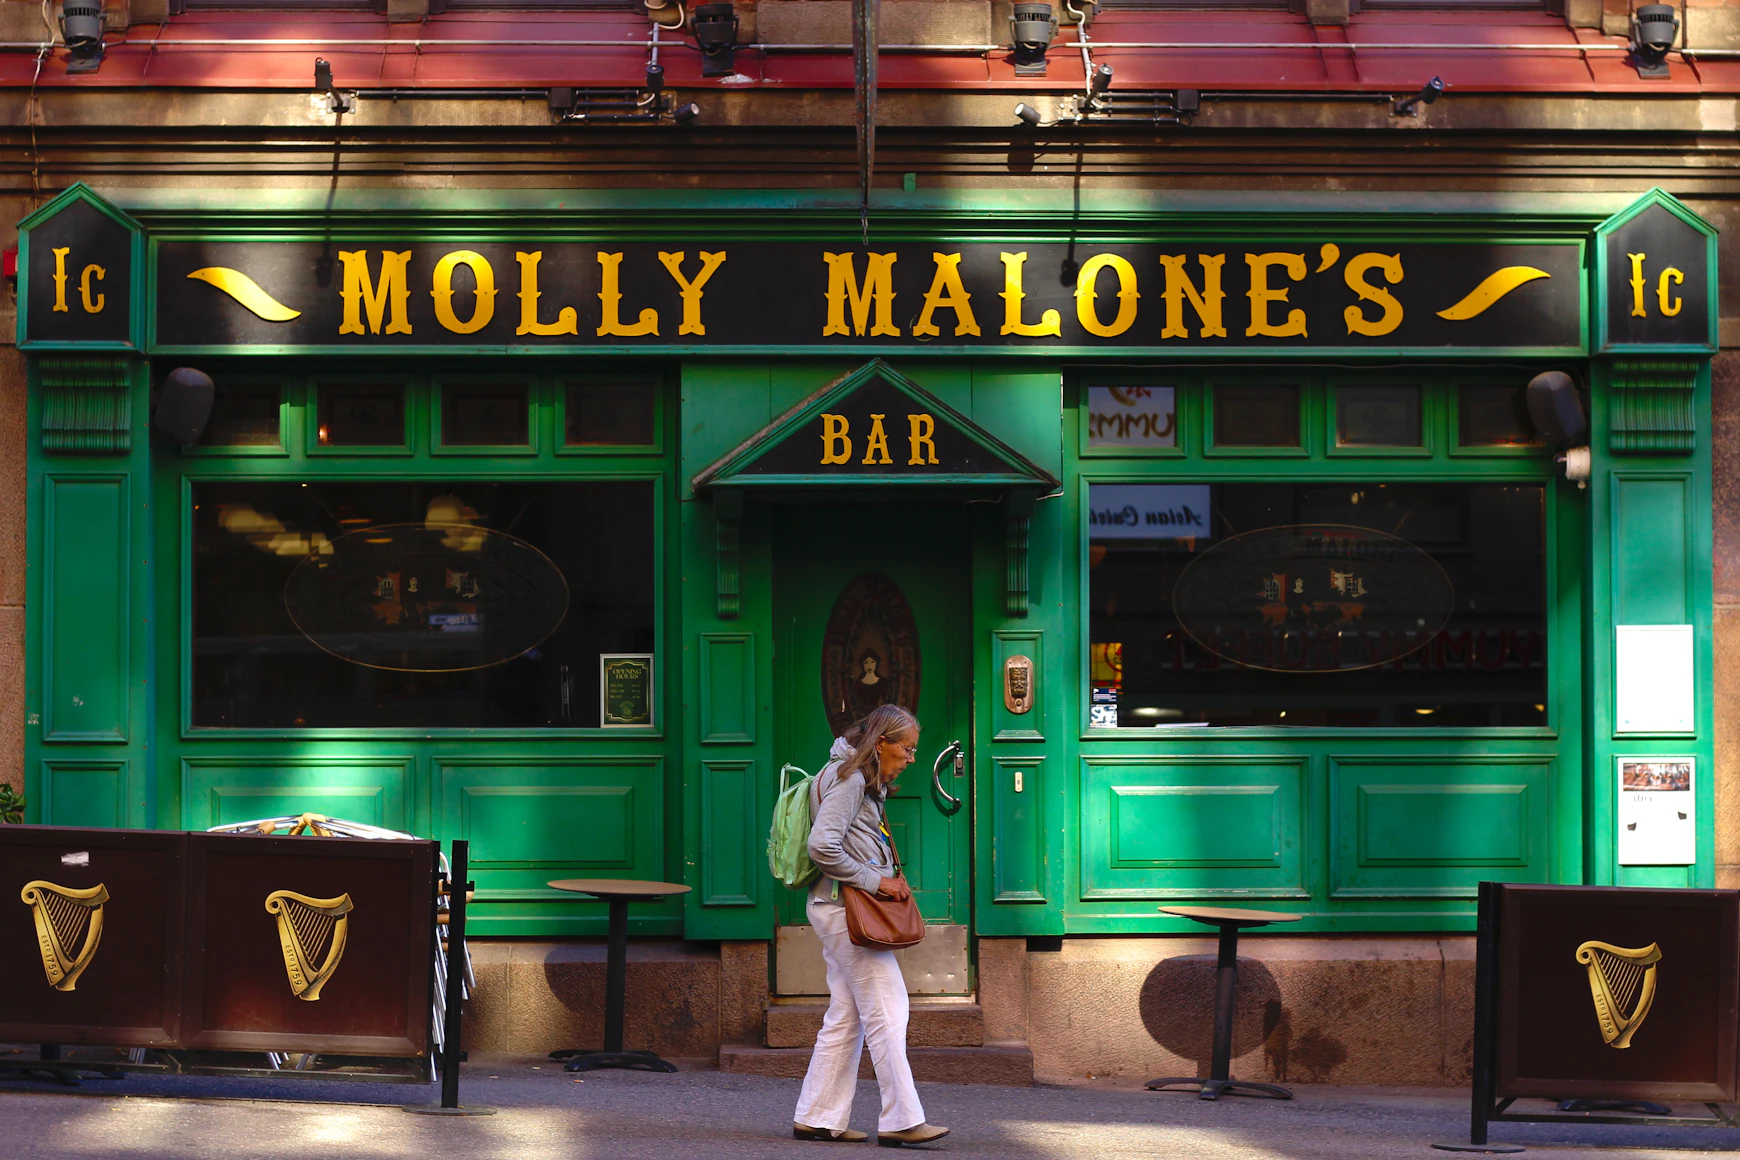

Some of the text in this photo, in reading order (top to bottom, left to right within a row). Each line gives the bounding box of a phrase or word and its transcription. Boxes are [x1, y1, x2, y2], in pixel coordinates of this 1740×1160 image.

[338, 243, 1406, 339] MOLLY MALONE'S
[820, 413, 940, 466] BAR
[45, 953, 59, 976] 1759
[289, 963, 303, 985] 1759
[1600, 1012, 1614, 1034] 1759
